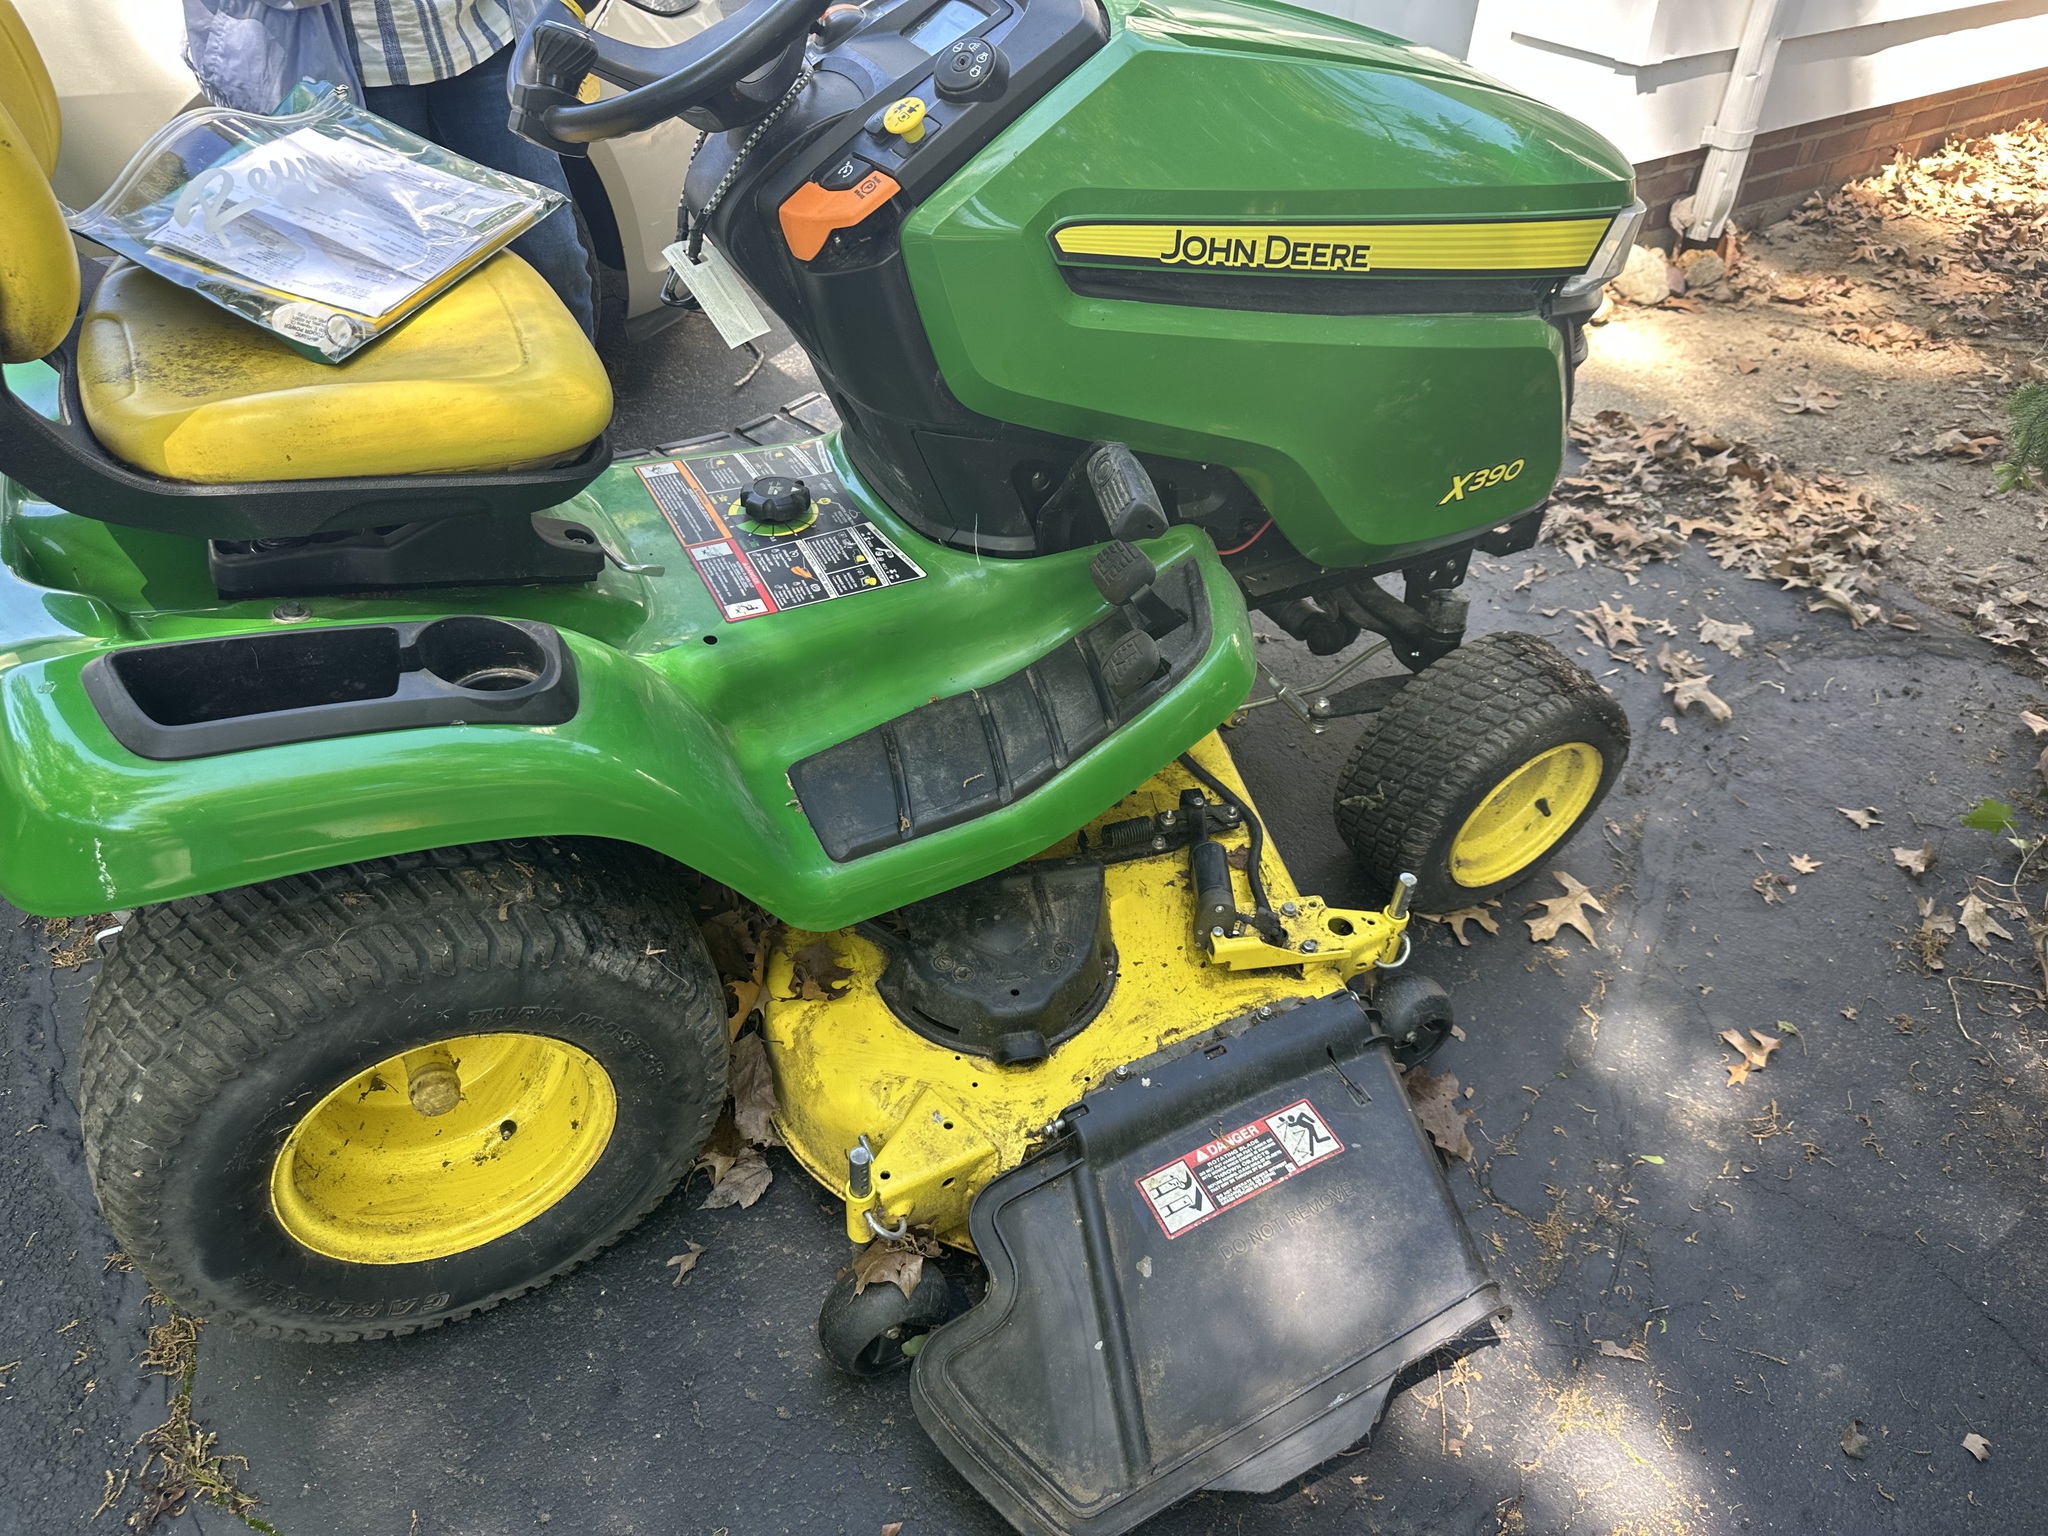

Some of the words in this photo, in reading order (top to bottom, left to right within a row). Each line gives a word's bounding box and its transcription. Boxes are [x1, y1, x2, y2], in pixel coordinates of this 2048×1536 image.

[1160, 229, 1258, 265] JOHN
[1264, 235, 1371, 268] DEERE
[1436, 459, 1525, 506] X390
[744, 565, 760, 584] DANGER
[566, 1011, 666, 1078] MASTER
[1206, 1148, 1238, 1166] ROTATING
[1237, 1138, 1259, 1151] BLADE
[1207, 1125, 1261, 1158] DANGER
[1213, 1163, 1241, 1180] THROWN
[1240, 1149, 1270, 1166] OBJECTS
[1220, 1238, 1246, 1262] DO
[1249, 1221, 1285, 1246] NOT
[1287, 1182, 1356, 1226] REMOVE
